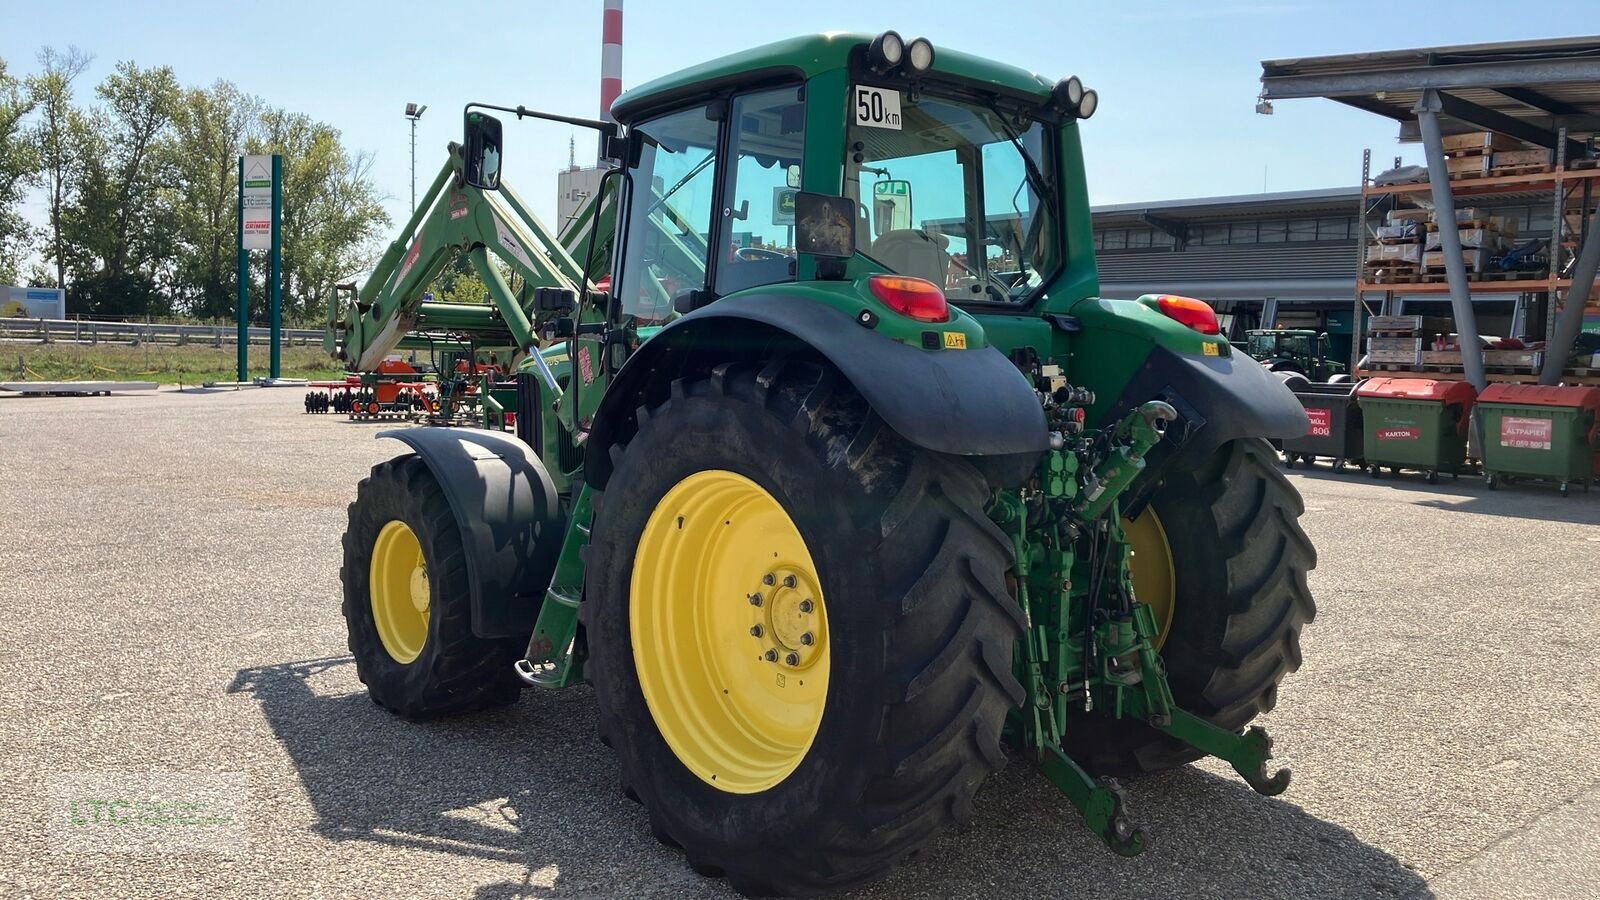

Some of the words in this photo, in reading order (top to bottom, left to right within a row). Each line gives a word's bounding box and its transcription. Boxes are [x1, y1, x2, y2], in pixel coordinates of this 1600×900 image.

[858, 89, 883, 122] 50
[885, 107, 900, 125] km
[1313, 426, 1330, 436] 800
[1507, 428, 1546, 436] ALTPAPIER
